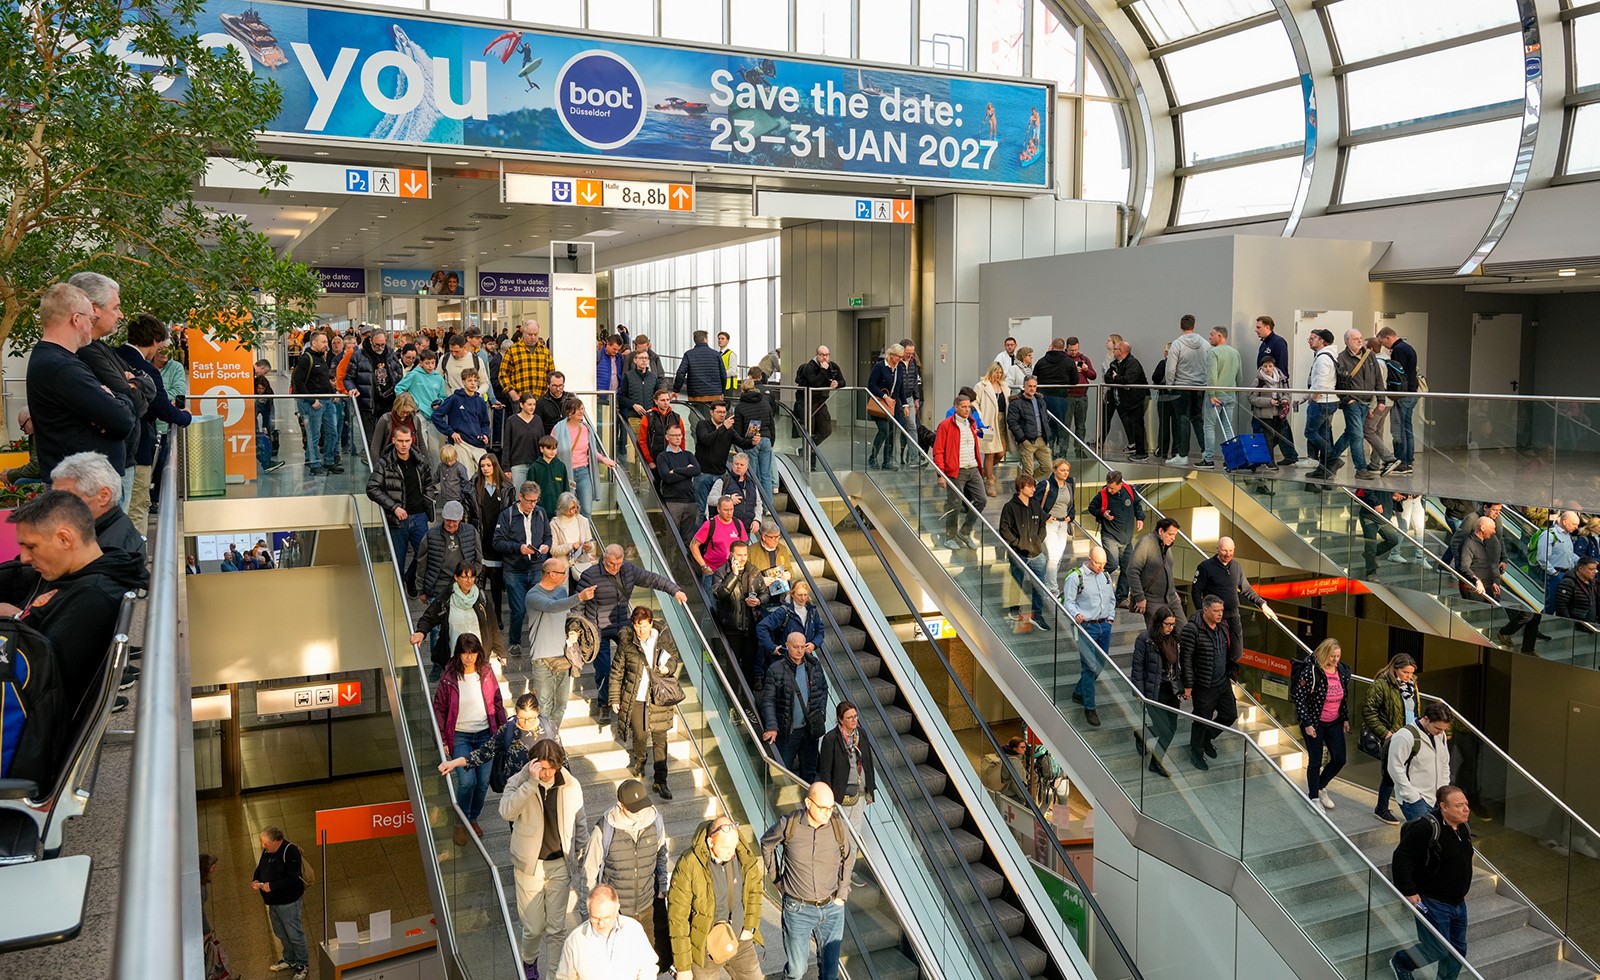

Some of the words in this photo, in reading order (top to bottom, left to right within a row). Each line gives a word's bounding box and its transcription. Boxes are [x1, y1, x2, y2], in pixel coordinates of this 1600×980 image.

[289, 41, 489, 132] you
[569, 81, 634, 109] boot
[709, 68, 801, 113] Save
[810, 80, 869, 119] the
[880, 86, 964, 128] date:
[569, 106, 611, 118] Düsseldorf
[837, 128, 908, 164] JAN
[918, 134, 999, 170] 2027
[341, 281, 359, 289] 2027
[383, 275, 407, 288] See
[410, 279, 433, 291] you
[192, 361, 214, 370] Fast
[216, 361, 241, 370] Lane
[192, 370, 215, 379] Surf
[217, 370, 250, 381] Sports
[227, 435, 252, 453] 17
[1254, 655, 1267, 665] Desk
[1270, 660, 1287, 670] Kasse
